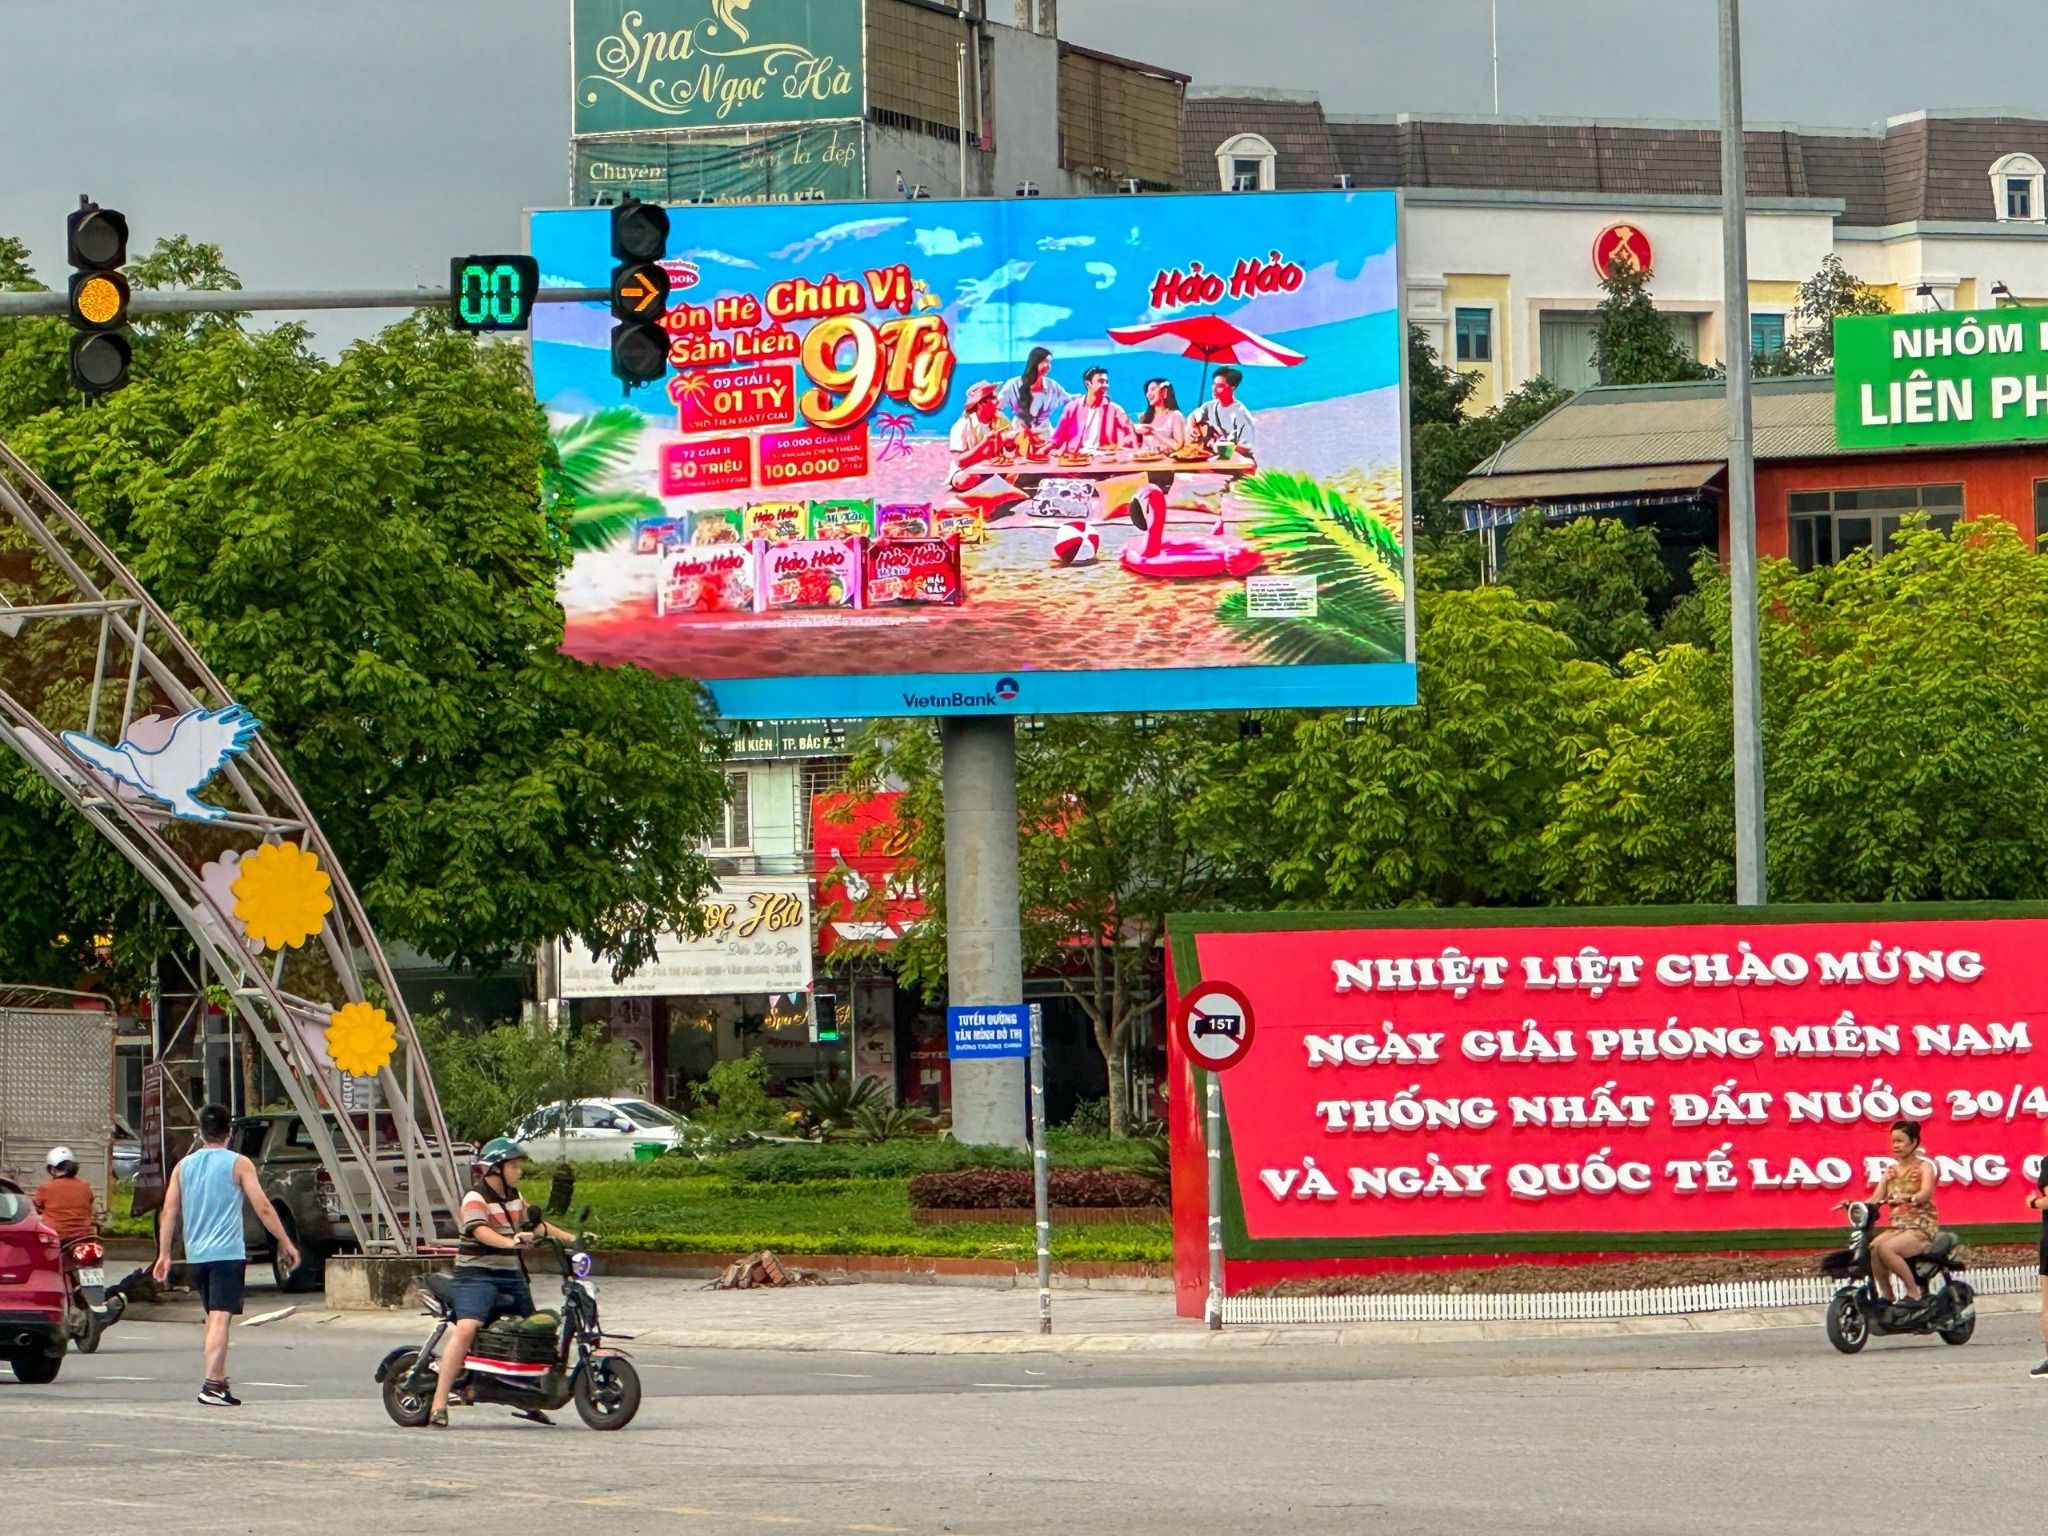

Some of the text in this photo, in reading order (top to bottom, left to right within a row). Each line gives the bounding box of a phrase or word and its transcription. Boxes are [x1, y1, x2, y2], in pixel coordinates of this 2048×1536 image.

[596, 10, 694, 84] Spa
[668, 53, 853, 119] Ngọc Hà
[459, 265, 520, 323] 00
[717, 295, 757, 323] Hè
[767, 275, 860, 316] Chín
[869, 266, 907, 309] Vị
[1152, 251, 1304, 308] Hảo Hảo
[672, 336, 726, 365] Săn
[1893, 316, 2023, 359] NHÔM
[714, 379, 731, 389] 09
[714, 379, 788, 414] 01 TỶ
[800, 315, 950, 429] 9 Tỷ
[1861, 368, 1973, 425] LIÊN
[671, 461, 697, 480] 50
[764, 458, 840, 480] 100.000
[903, 691, 997, 708] VietinBank
[730, 735, 746, 752] HÍ
[783, 738, 797, 750] TP.
[1331, 940, 1986, 999] NHIỆT LIỆT CHÀO MỪNG
[1209, 1018, 1235, 1031] 15T
[1303, 1009, 2032, 1068] NGÀY GIẢI PHÓNG MIỀN NAM
[1315, 1083, 1498, 1133] THỐNG
[1508, 1080, 1655, 1128] NHẤT
[1669, 1078, 1773, 1128] ĐẤT
[1784, 1078, 1934, 1124] NƯỚC
[1259, 1155, 1338, 1201] VÀ
[1347, 1152, 1492, 1200] NGÀY
[1506, 1146, 1652, 1201] QUỐC
[1665, 1141, 1738, 1195] TẾ
[1747, 1156, 1852, 1192] LAO
